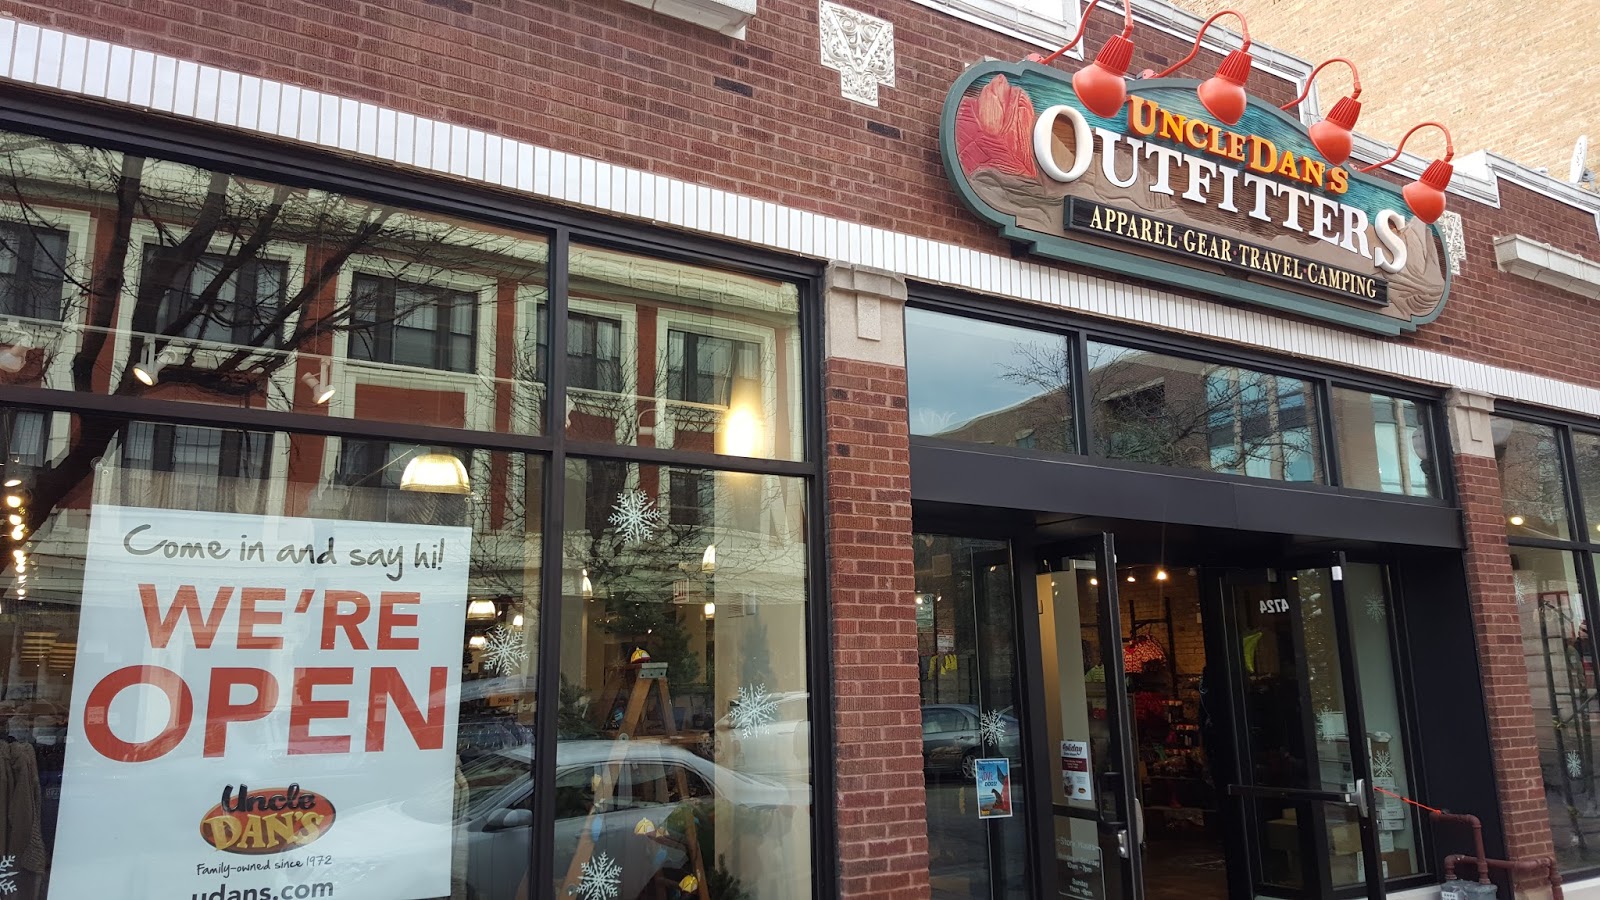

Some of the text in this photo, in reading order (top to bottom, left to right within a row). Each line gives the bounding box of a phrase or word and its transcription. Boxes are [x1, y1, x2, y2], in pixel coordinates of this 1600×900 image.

[1127, 94, 1246, 162] UNCLE
[1033, 104, 1407, 274] OUTFITTERS
[1089, 205, 1377, 299] APPAREL GEAR TRAVEL CAMPING
[123, 524, 446, 581] Come in and say hi!
[137, 583, 421, 651] WE'RE
[83, 664, 449, 763] OPEN
[203, 811, 325, 851] DAN'S
[221, 782, 316, 813] Uncle
[196, 855, 333, 878] Family-owned since 1972
